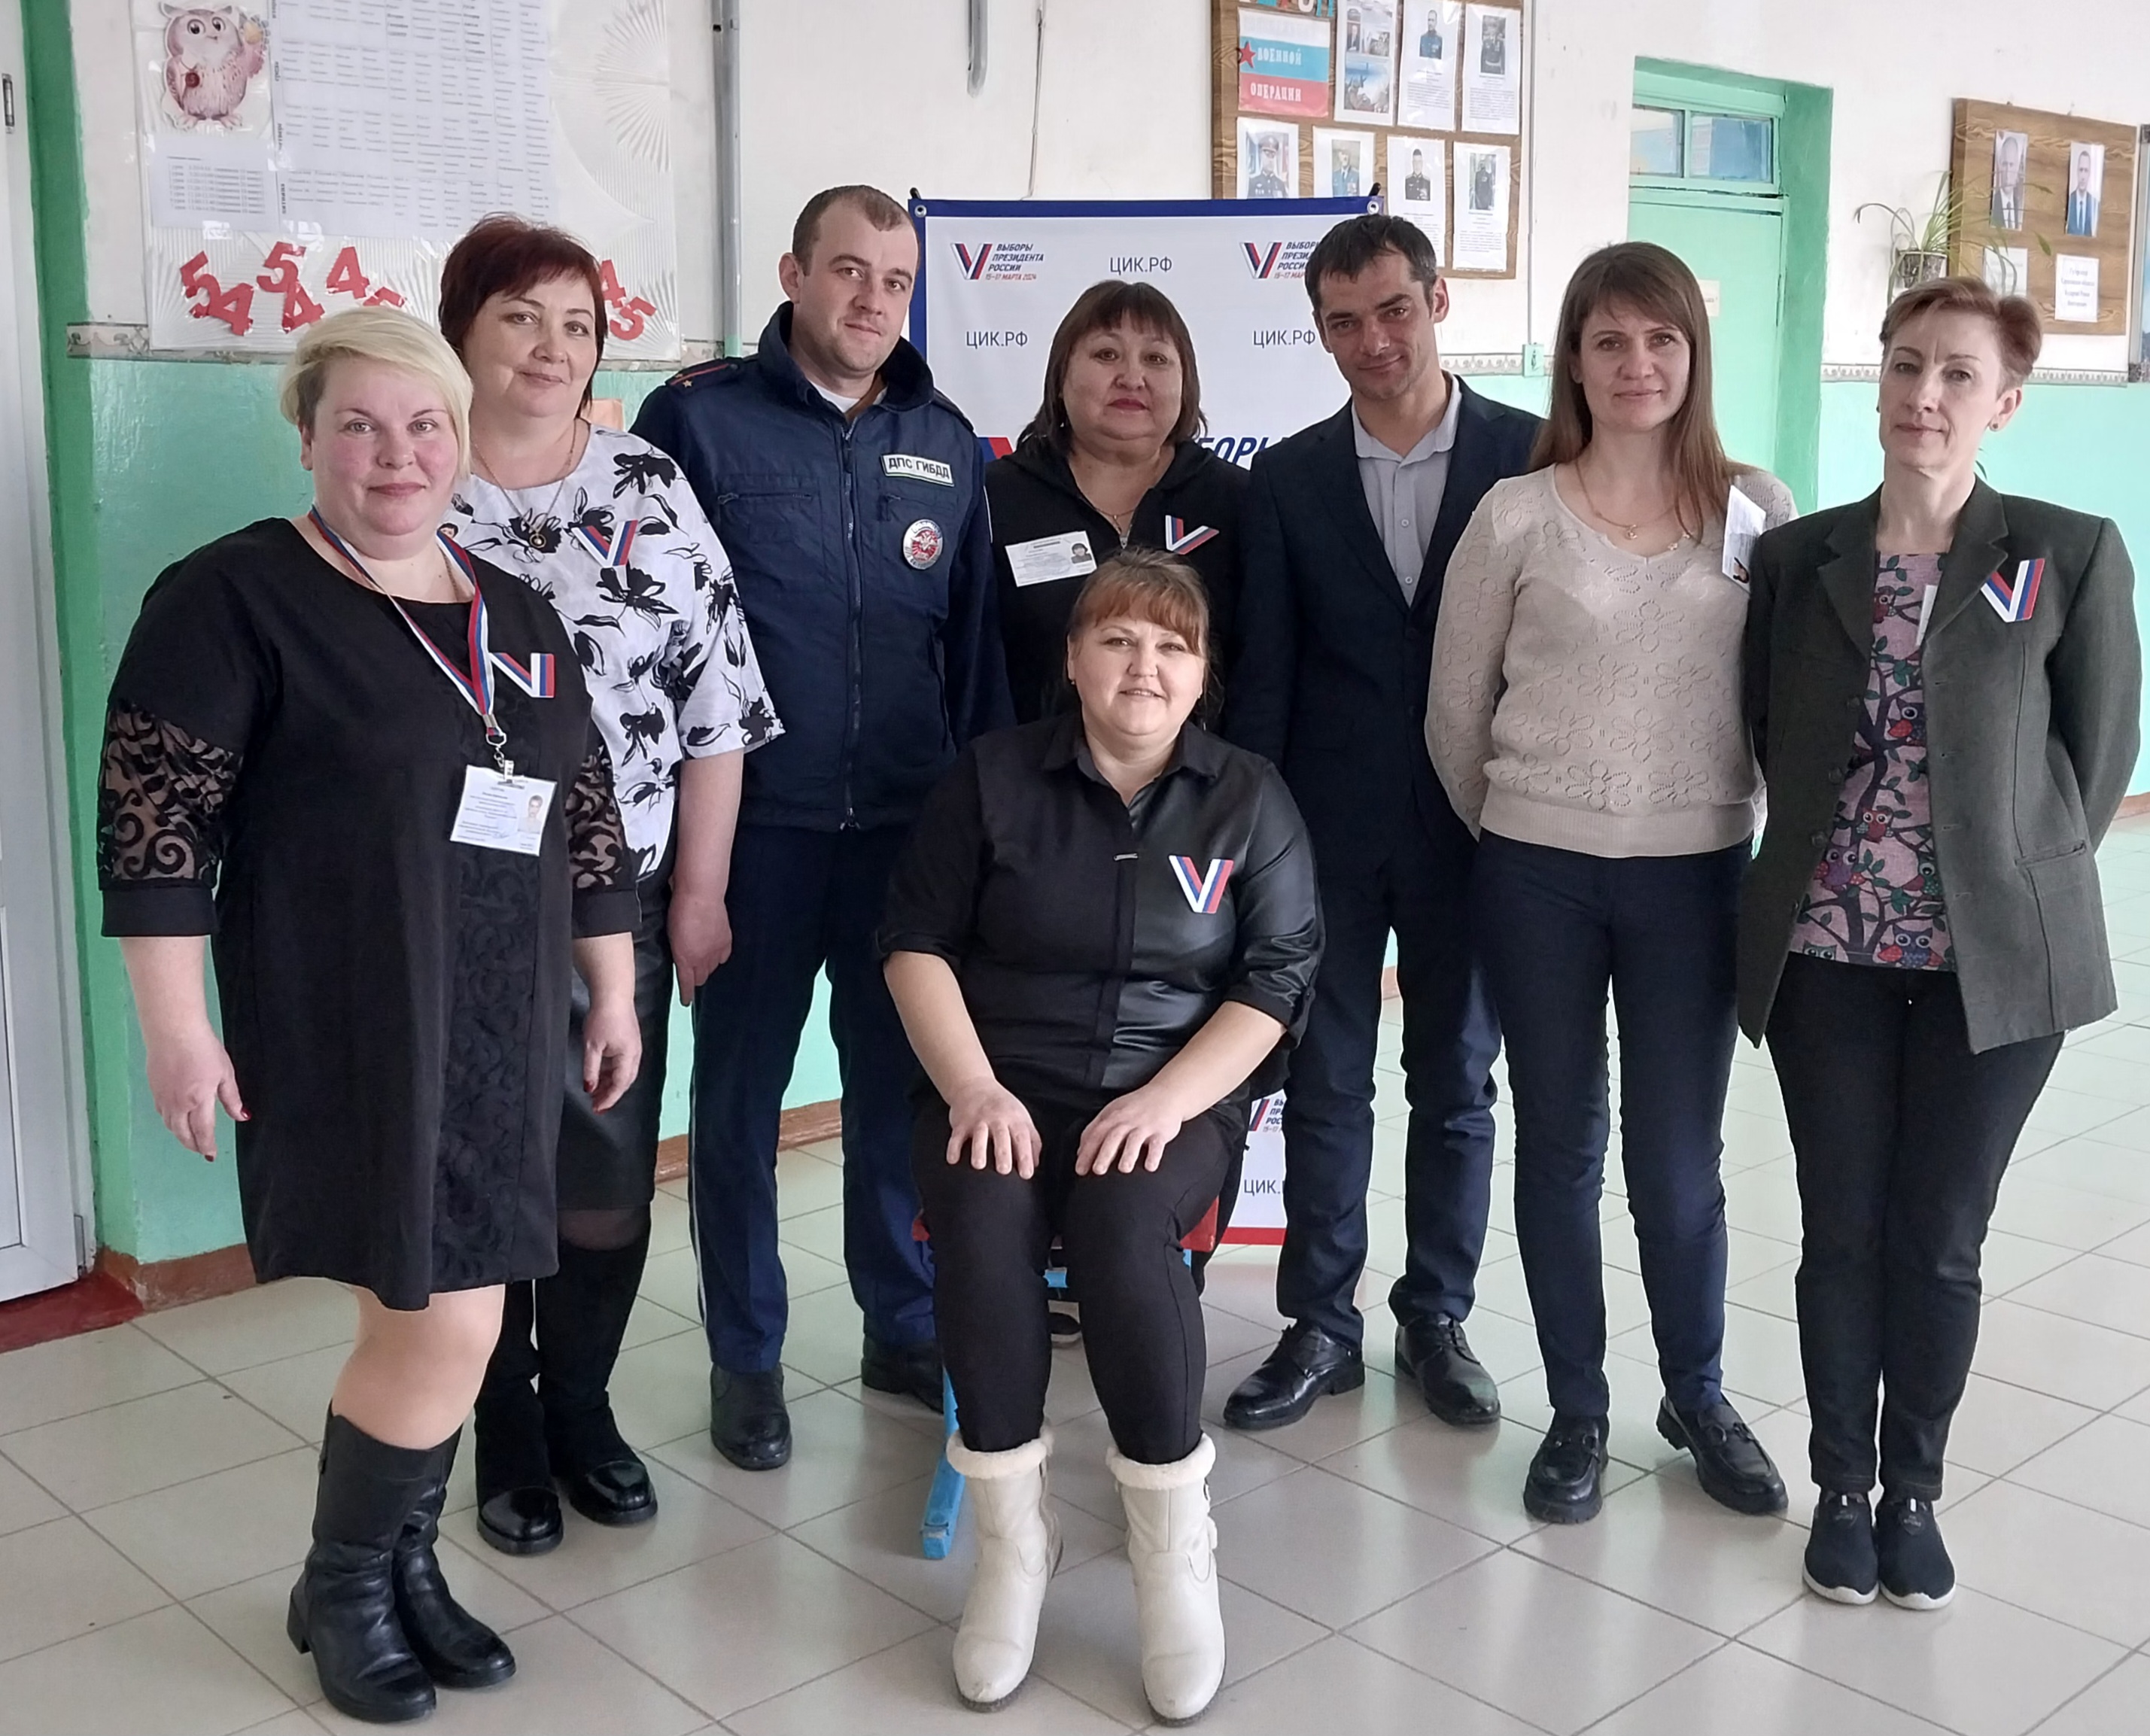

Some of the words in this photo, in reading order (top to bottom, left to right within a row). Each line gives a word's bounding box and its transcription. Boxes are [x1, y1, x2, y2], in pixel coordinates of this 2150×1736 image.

[1250, 81, 1302, 102] ОПЕРАЦИИ
[996, 243, 1034, 252] ВЫБОРЫ
[992, 253, 1045, 263] ПРЕЗИДЕНТА
[1110, 256, 1172, 275] ЦИК.РФ
[1276, 262, 1306, 270] РОССИ
[987, 263, 1022, 272] РОССИИ
[966, 331, 1028, 349] ЦИК.РФ
[1254, 330, 1315, 348] ЦИК.РФ
[888, 457, 914, 470] ДПС
[915, 460, 950, 479] ГИБДД
[1244, 1179, 1285, 1196] ЦИК.
